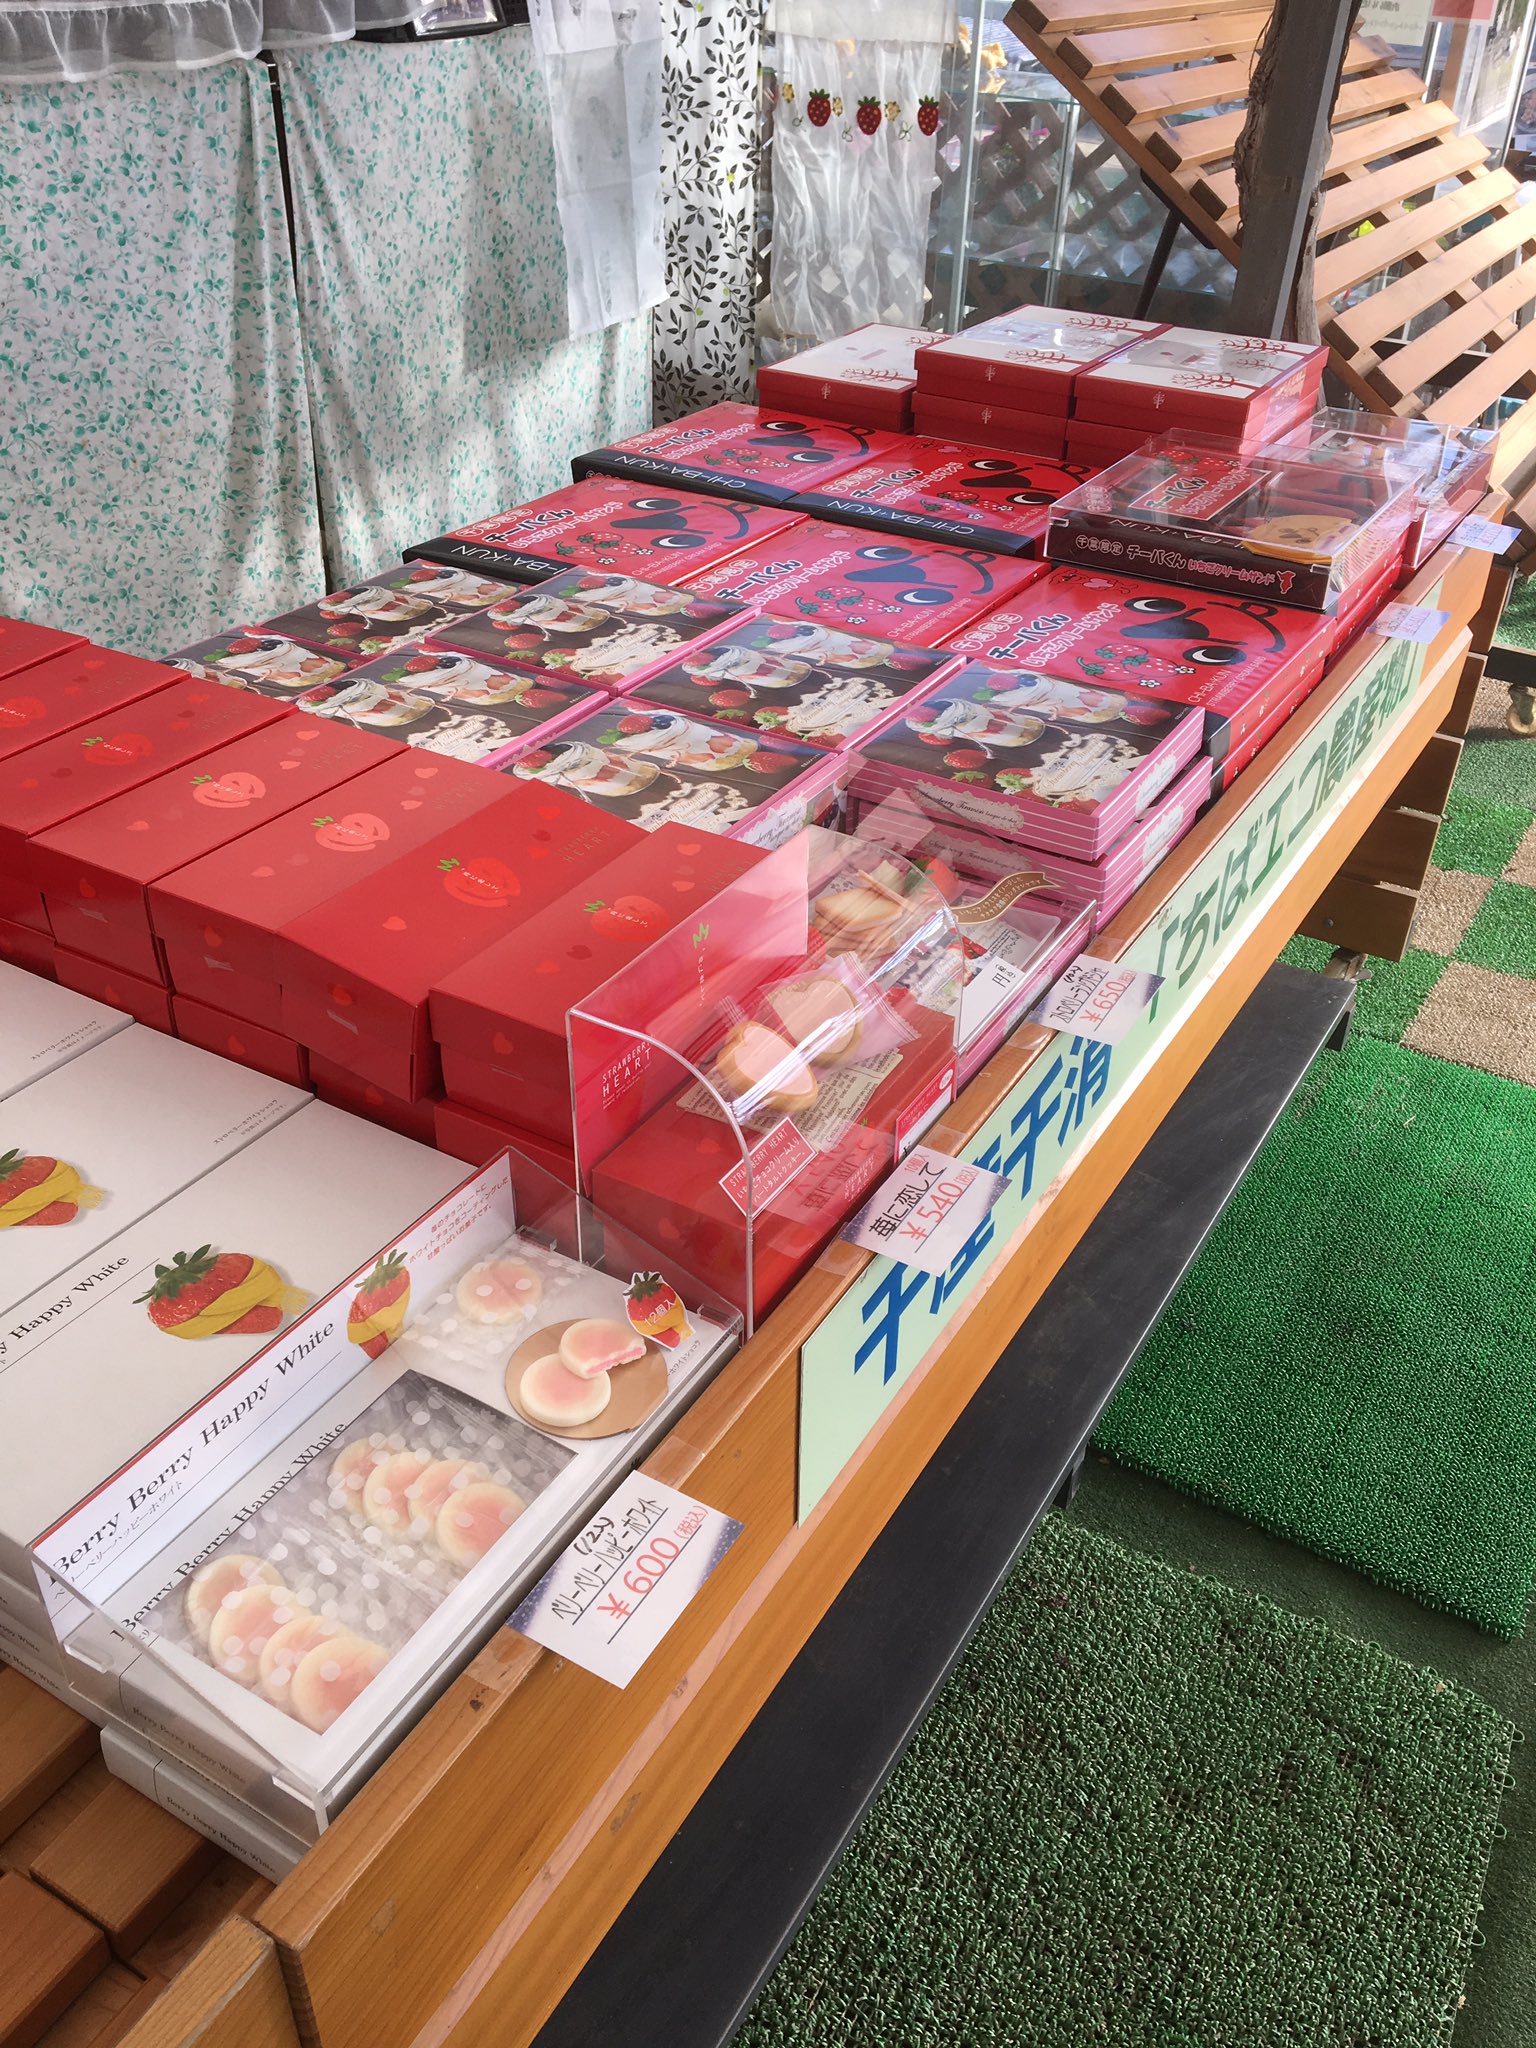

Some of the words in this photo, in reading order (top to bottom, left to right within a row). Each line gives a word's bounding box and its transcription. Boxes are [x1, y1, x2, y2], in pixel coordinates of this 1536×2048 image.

[639, 427, 715, 455] チーバくん
[850, 468, 923, 498] チーバくん
[482, 507, 576, 544] チーバくん
[451, 545, 568, 575] I-BA+KUN
[716, 559, 804, 600] チーバくん
[1127, 545, 1186, 570] チーバくん
[1188, 561, 1275, 586] いちごクリームサンド
[988, 613, 1071, 660] チーバくん
[1019, 601, 1121, 667] いちごクリームサンド
[1079, 981, 1128, 1022] ¥650
[602, 1049, 652, 1096] HEART
[767, 1127, 788, 1149] HEART
[869, 1162, 947, 1237] 苺に恋して
[900, 1182, 964, 1240] ¥540
[8, 1294, 74, 1341] Happy
[72, 1254, 129, 1293] White
[644, 1299, 678, 1328] 12個入
[126, 1446, 194, 1511] Berry
[199, 1377, 271, 1447] Happy
[274, 1321, 335, 1376] White
[290, 1421, 347, 1468] White
[552, 1498, 665, 1620] ベリーベリーハッピーホワイト
[597, 1537, 680, 1620] ¥600
[674, 1505, 709, 1540] (税込)
